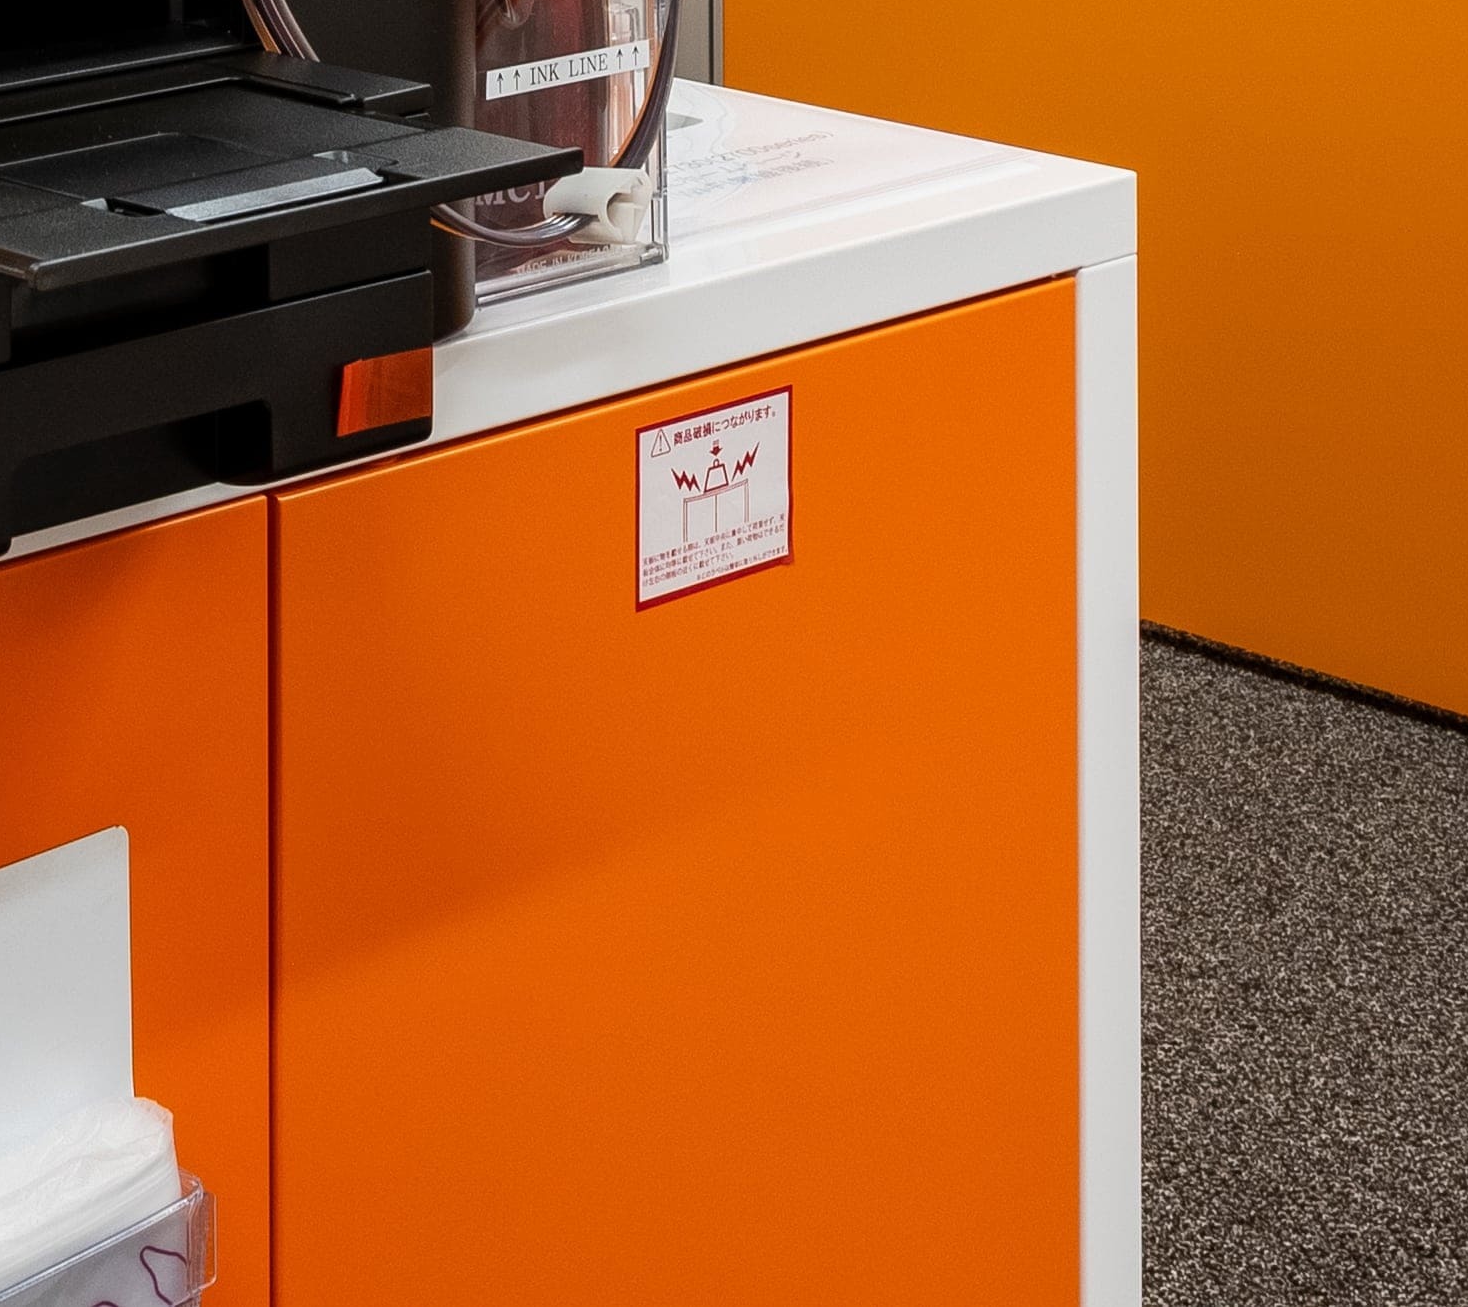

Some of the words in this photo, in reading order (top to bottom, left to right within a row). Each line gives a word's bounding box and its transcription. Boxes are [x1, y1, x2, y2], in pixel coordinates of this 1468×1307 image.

[529, 63, 561, 85] INK
[569, 52, 609, 78] LINE
[673, 403, 776, 447] 商品破損につながります。
